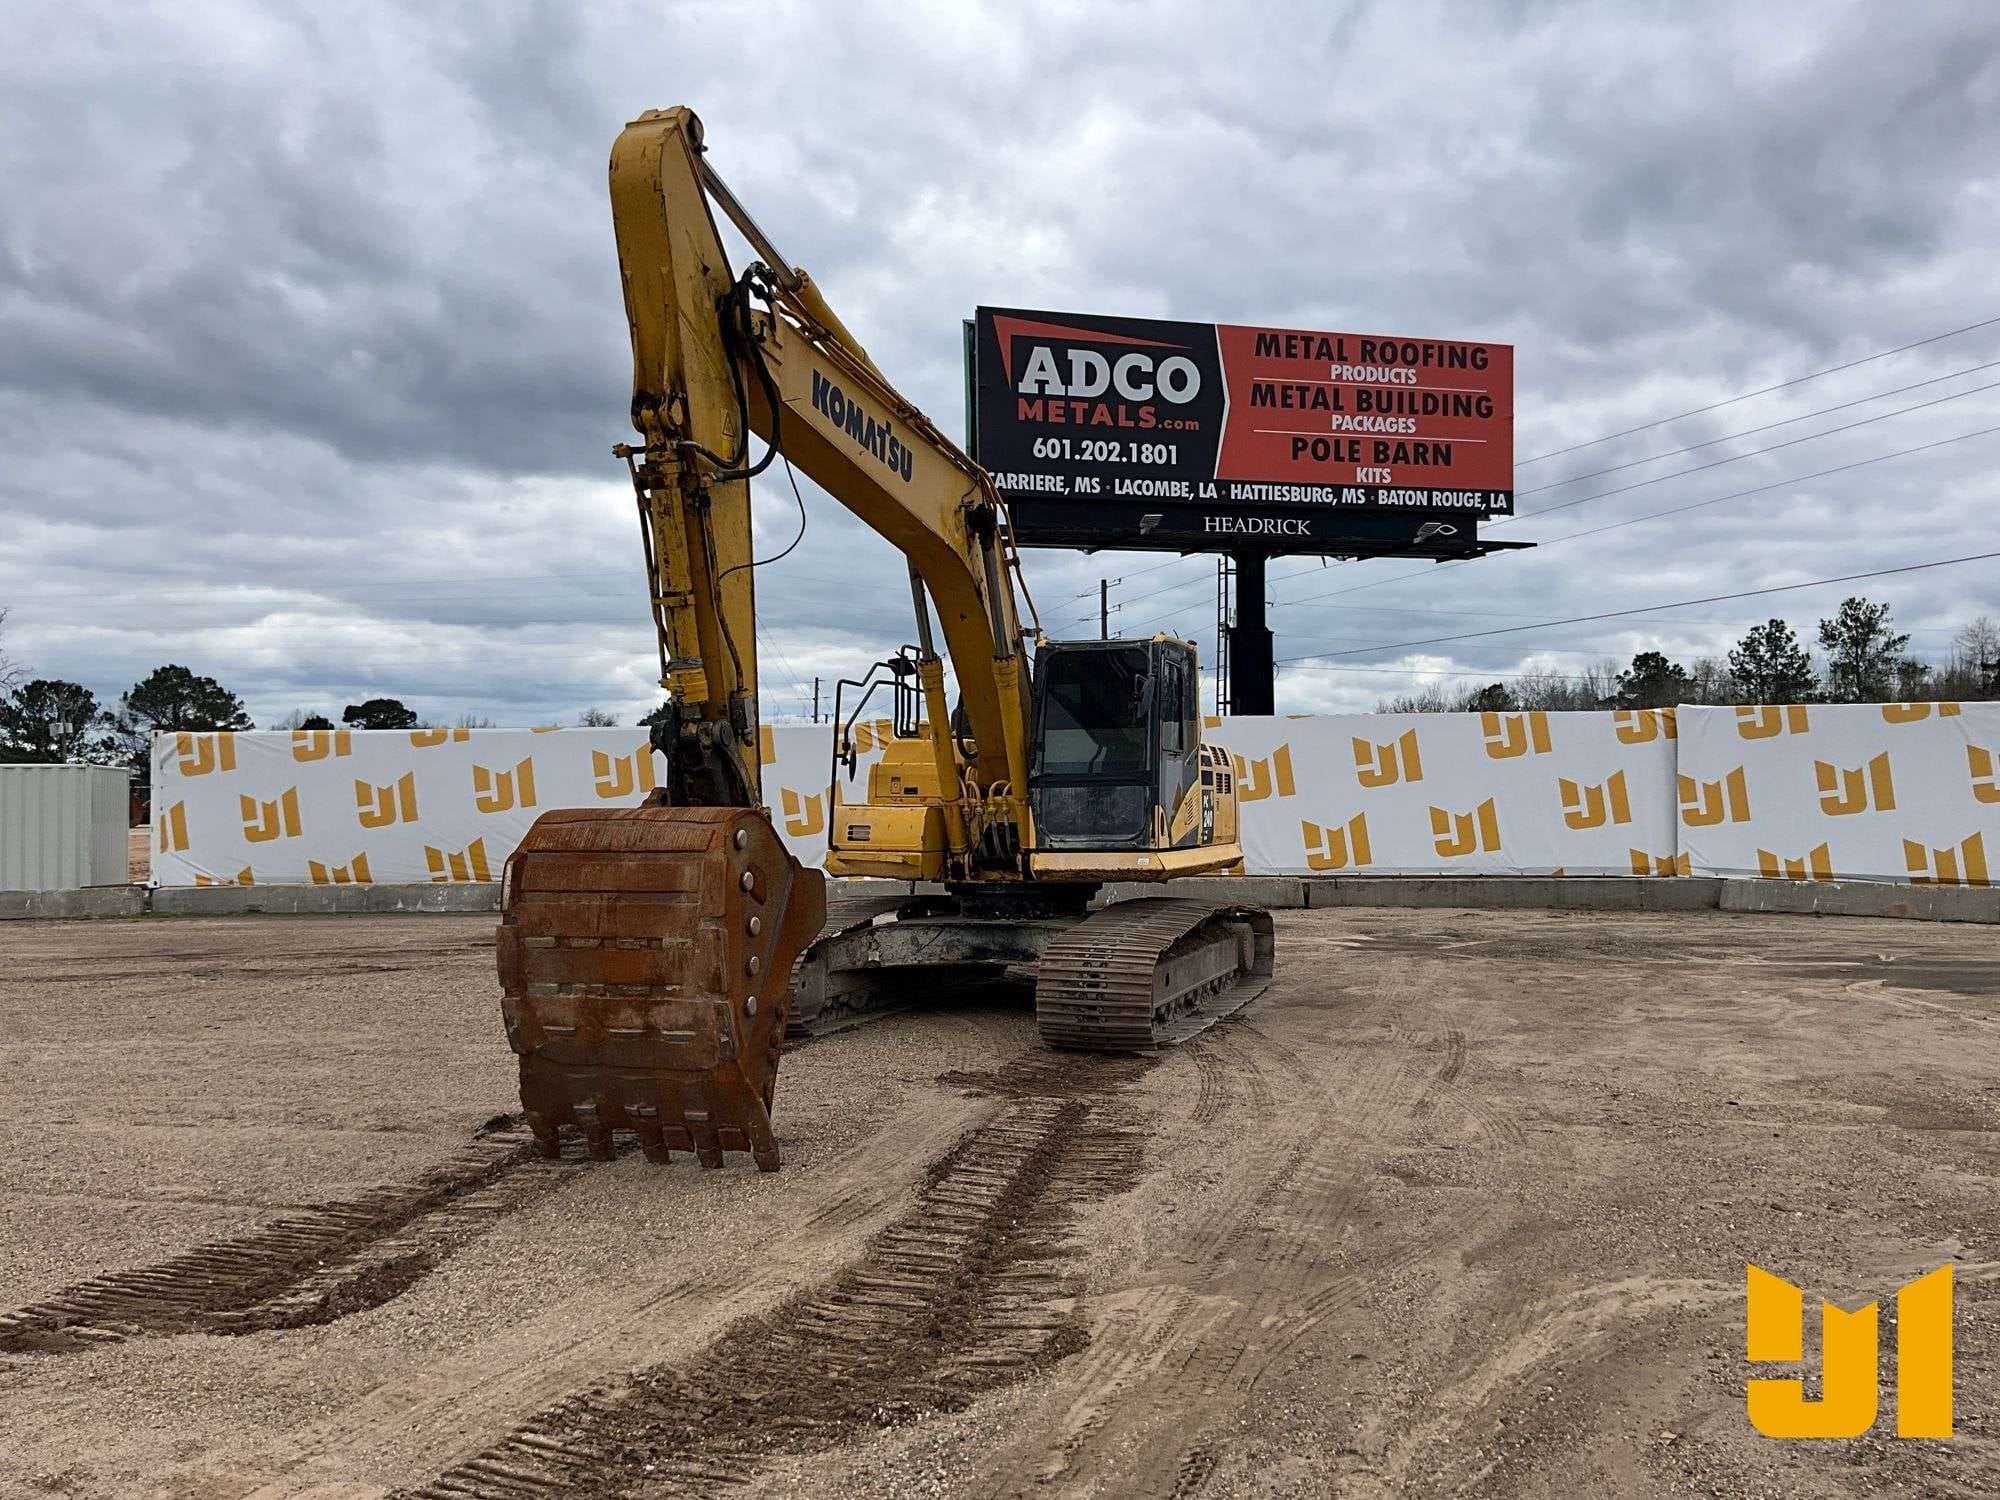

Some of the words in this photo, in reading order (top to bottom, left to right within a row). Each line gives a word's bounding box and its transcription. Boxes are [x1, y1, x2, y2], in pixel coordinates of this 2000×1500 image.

[1255, 333, 1348, 362] METAL
[1360, 339, 1489, 370] ROOFING
[1018, 346, 1201, 404] ADCO
[1330, 364, 1417, 384] PRODUCTS
[1250, 384, 1344, 411] METAL
[1356, 390, 1494, 419] BUILDING
[812, 368, 913, 483] KOMATSU
[1331, 414, 1416, 434] PACKAGES
[1033, 437, 1178, 465] 601.202.1801
[1291, 437, 1361, 463] POLE
[1373, 442, 1452, 467] BARN
[1356, 467, 1392, 484] KITS
[988, 472, 1070, 495] ARRIERE,
[1074, 477, 1101, 493] MS
[1114, 478, 1195, 500] LACOMBE,
[1199, 482, 1218, 499] LA
[1230, 484, 1338, 505] HATTIESBURG,
[1341, 488, 1366, 504] MS
[1378, 489, 1428, 506] BATON
[1432, 492, 1486, 510] ROUGE,
[1490, 493, 1507, 508] LA
[1205, 516, 1311, 535] HEADRICK
